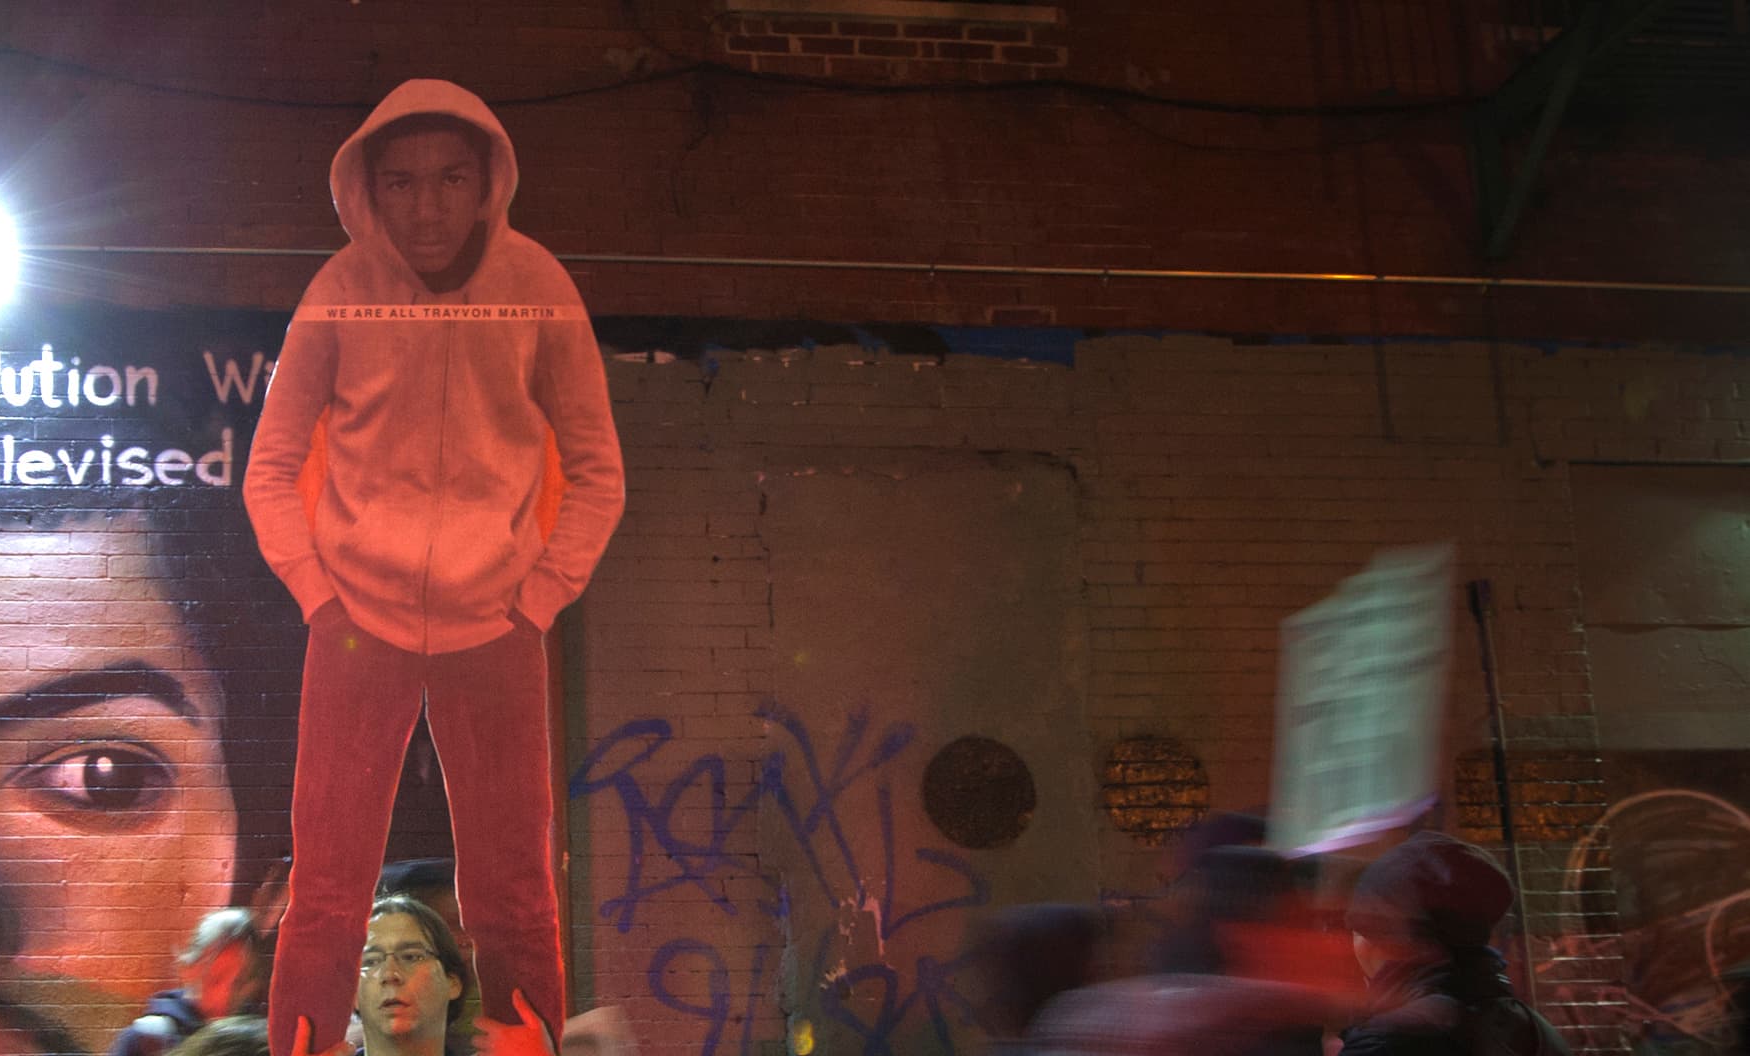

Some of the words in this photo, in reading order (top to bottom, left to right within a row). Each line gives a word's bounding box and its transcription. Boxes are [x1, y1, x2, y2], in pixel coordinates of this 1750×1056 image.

[326, 307, 348, 319] WE
[353, 307, 383, 319] ARE
[388, 307, 417, 319] ALL
[422, 307, 493, 319] TRAYVON
[497, 307, 555, 319] MARTIN
